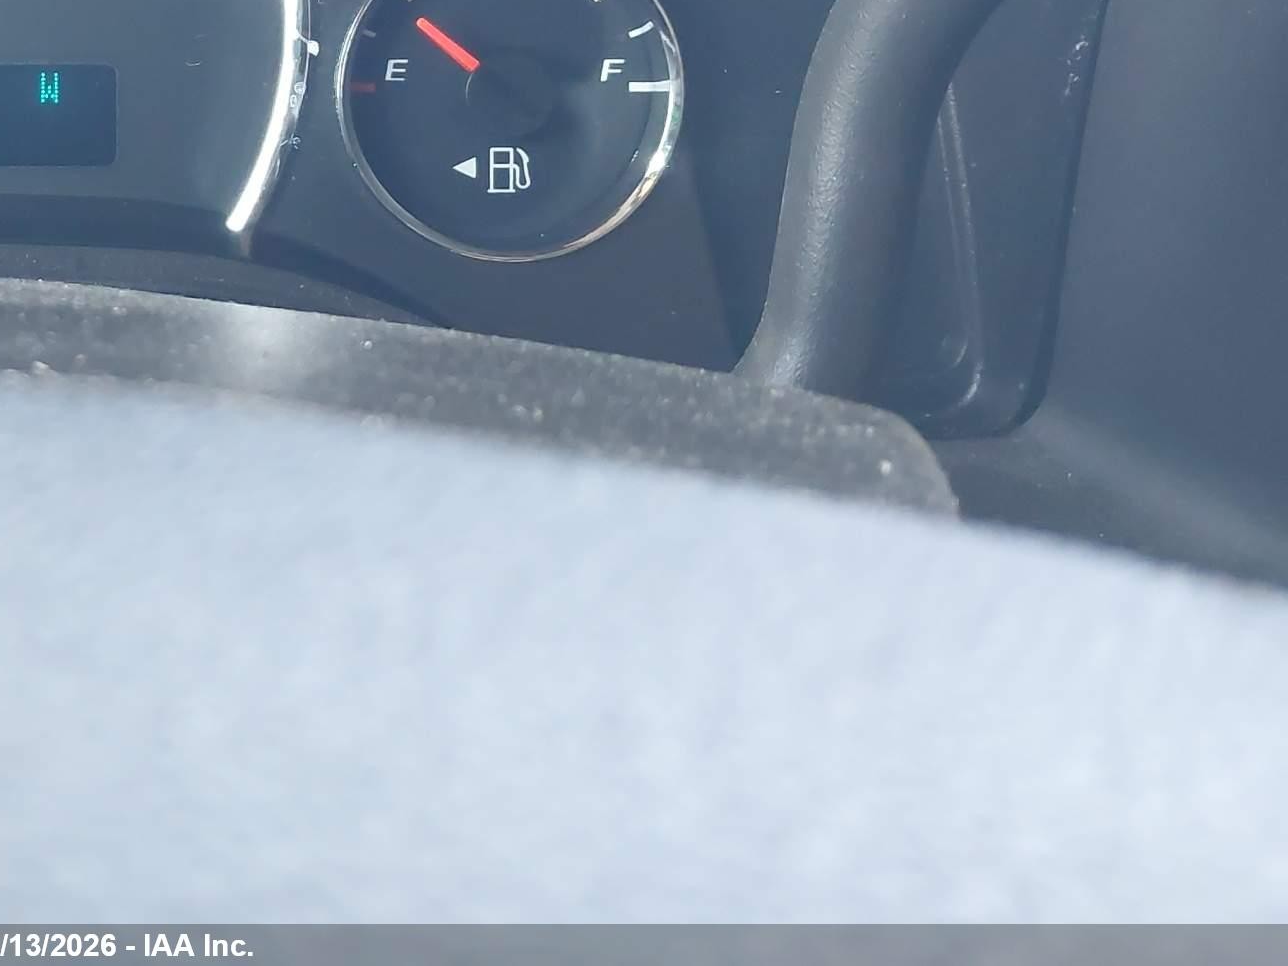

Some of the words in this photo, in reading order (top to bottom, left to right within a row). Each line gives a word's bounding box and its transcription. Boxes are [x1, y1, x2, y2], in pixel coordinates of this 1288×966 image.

[384, 59, 409, 81] E
[600, 59, 625, 82] F
[40, 72, 60, 103] W
